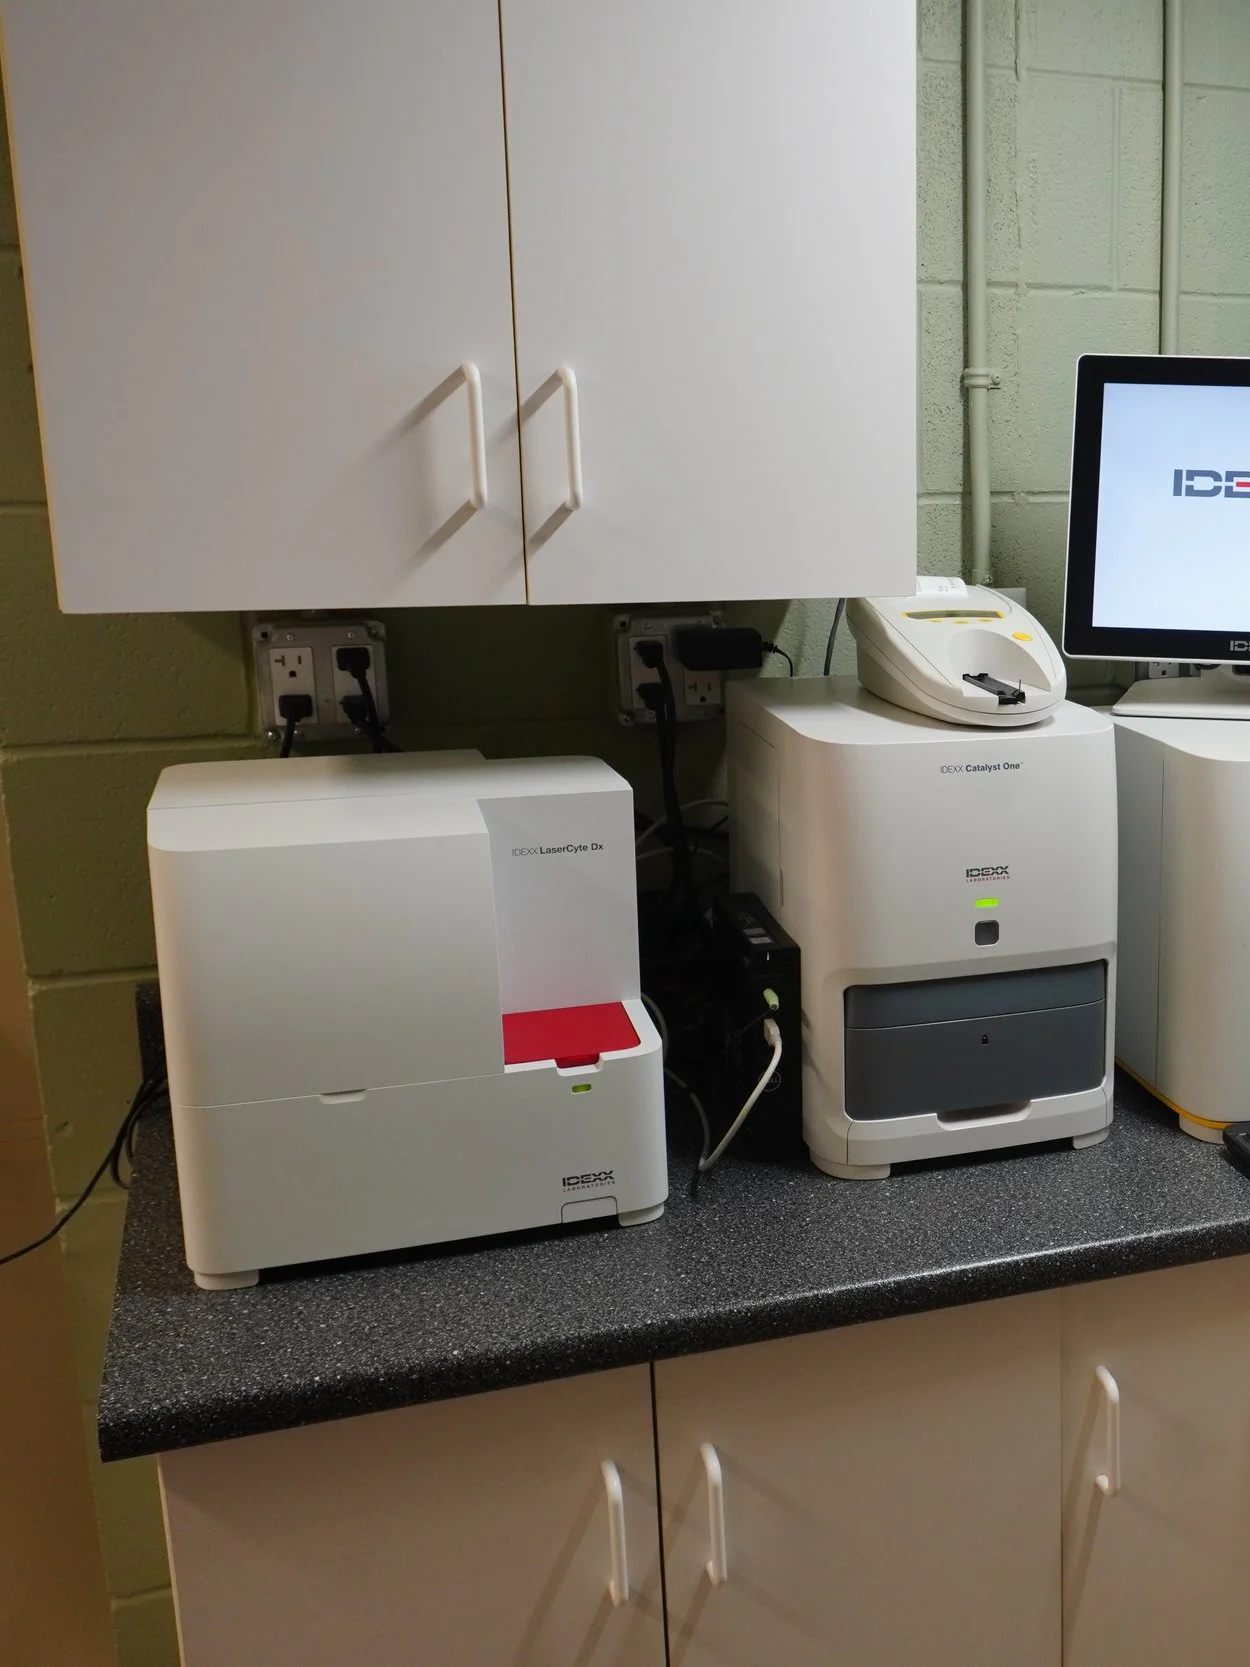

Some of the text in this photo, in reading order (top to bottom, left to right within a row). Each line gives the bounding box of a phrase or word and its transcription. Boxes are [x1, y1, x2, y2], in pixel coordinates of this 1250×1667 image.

[940, 765, 964, 774] IDEXX
[965, 763, 1001, 773] Catalyst
[512, 842, 604, 857] IDEXX LaserCyte Dx
[966, 865, 1010, 878] IDEXX
[966, 875, 1010, 883] LABORATORIES
[562, 1170, 615, 1187] IDEXX
[562, 1180, 616, 1193] LABORATORIES
